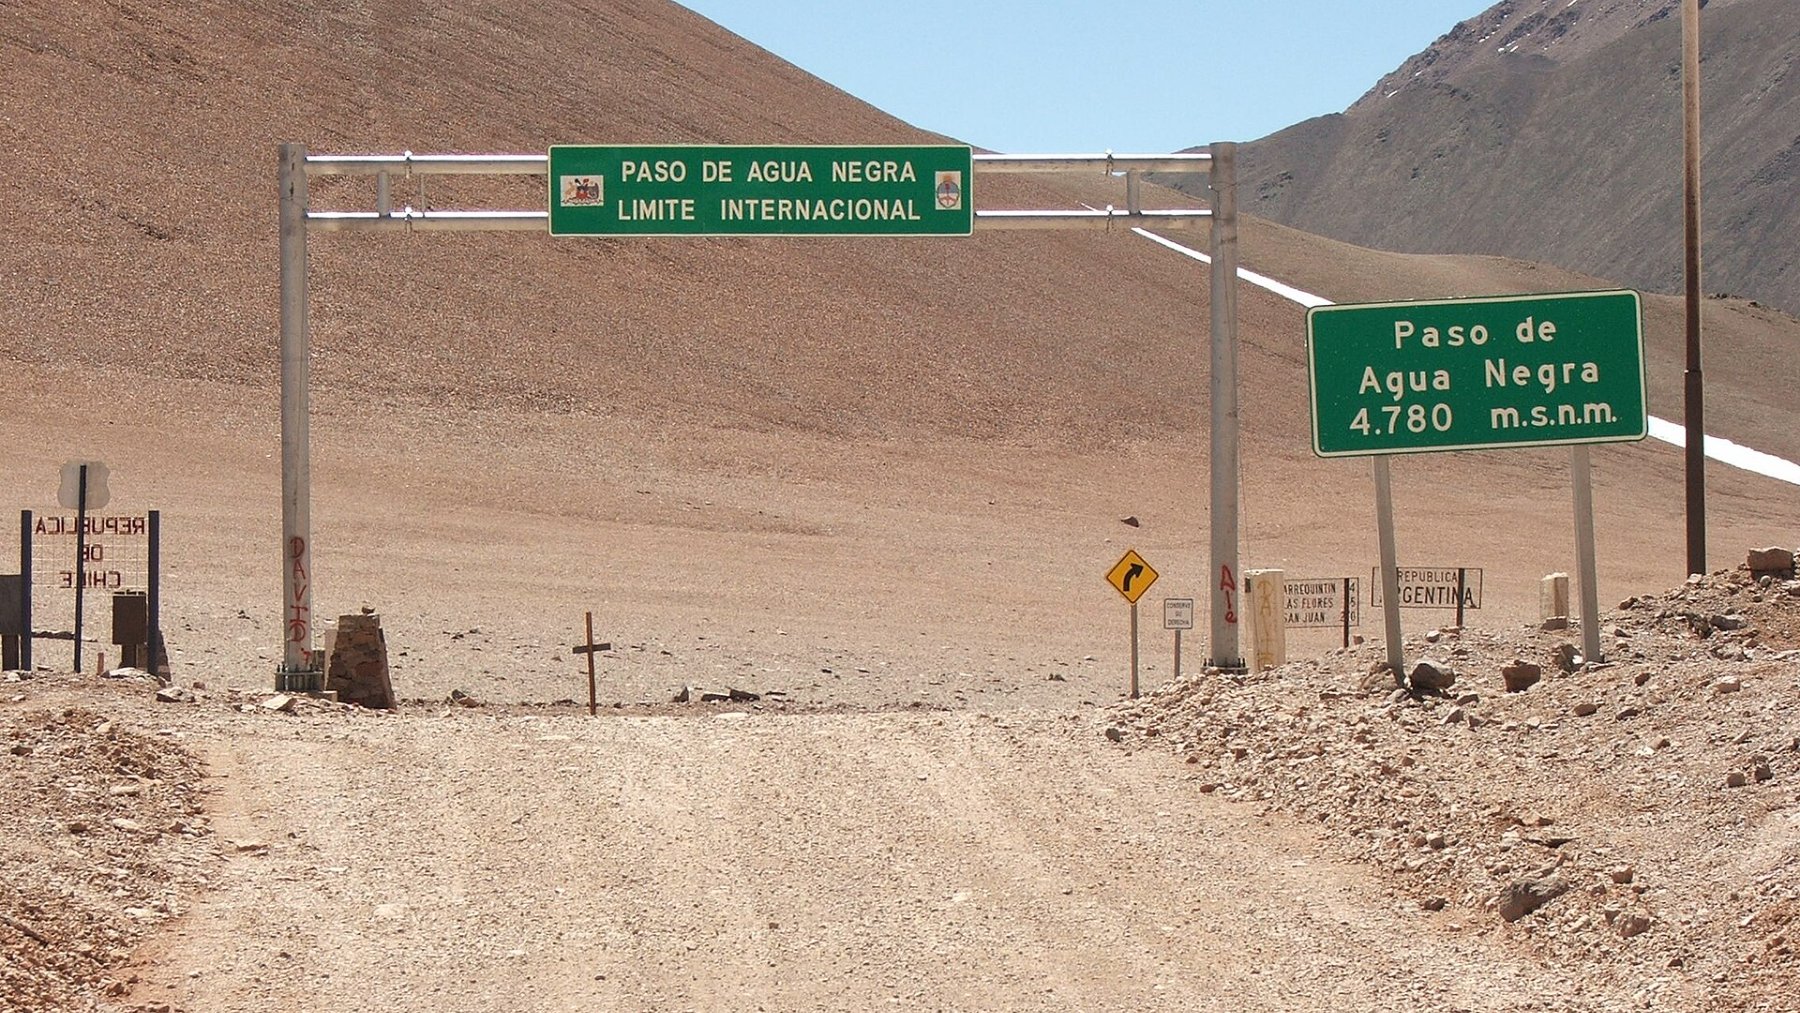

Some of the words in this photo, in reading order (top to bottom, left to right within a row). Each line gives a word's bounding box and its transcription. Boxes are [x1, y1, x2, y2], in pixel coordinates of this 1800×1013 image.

[621, 160, 687, 183] PASO
[702, 160, 732, 183] DE
[746, 160, 813, 183] AGUA
[832, 160, 917, 183] NEGRA
[617, 199, 695, 221] LIMITE
[720, 199, 921, 221] INTERNACIONAL
[1394, 320, 1489, 349] Paso
[1516, 316, 1557, 343] de
[1358, 366, 1451, 401] Agua
[1484, 358, 1599, 394] Negra
[1349, 403, 1453, 436] 4.780
[1490, 401, 1618, 429] m.s.n.m.
[1398, 570, 1458, 583] REPUBLICA
[289, 536, 309, 642] DAVID
[1380, 586, 1475, 606] GENTINA
[1301, 598, 1334, 609] FLORES
[1302, 612, 1325, 623] JUAN
